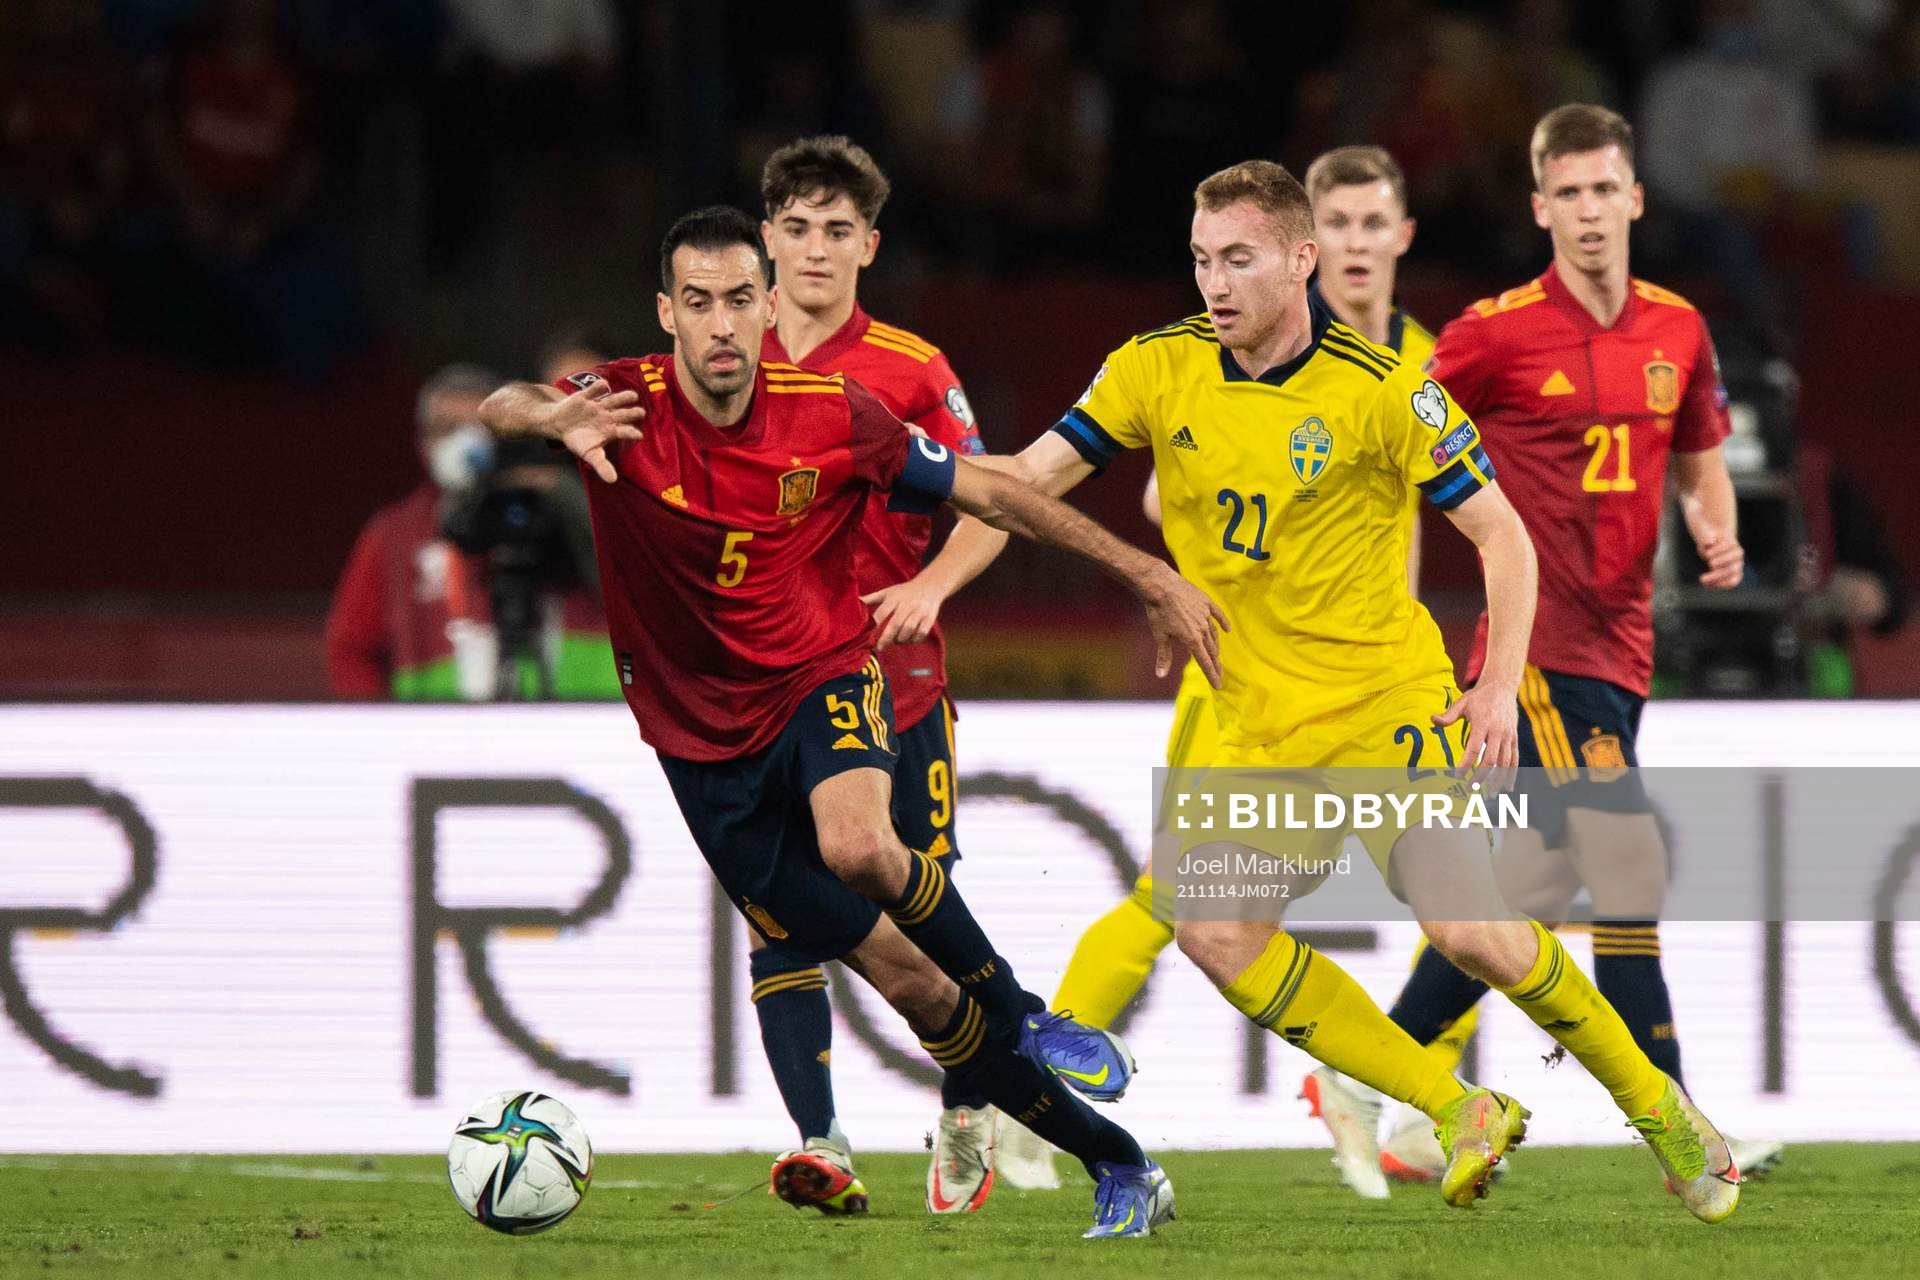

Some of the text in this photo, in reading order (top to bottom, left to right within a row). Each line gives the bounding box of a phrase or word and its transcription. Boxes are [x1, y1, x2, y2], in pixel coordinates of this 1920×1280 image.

[1169, 439, 1199, 451] adidas
[1445, 424, 1474, 455] RESPECT
[1582, 423, 1637, 493] 21
[1217, 488, 1271, 562] 21
[715, 531, 755, 589] 5
[825, 693, 860, 730] 5
[1393, 723, 1457, 782] 21
[927, 759, 950, 828] 9
